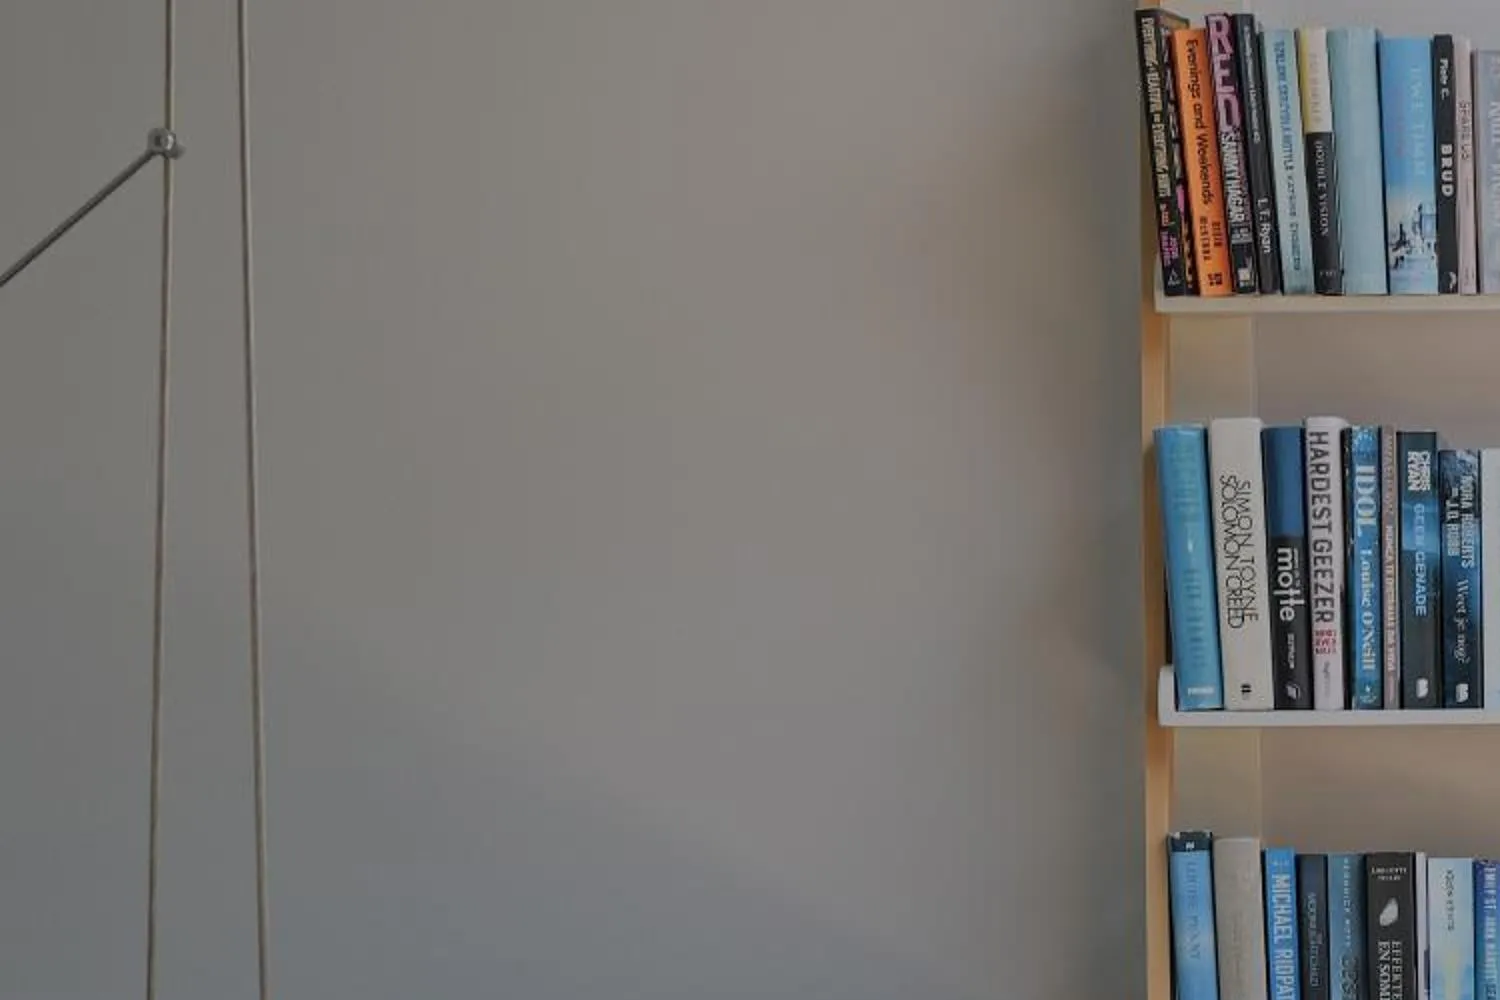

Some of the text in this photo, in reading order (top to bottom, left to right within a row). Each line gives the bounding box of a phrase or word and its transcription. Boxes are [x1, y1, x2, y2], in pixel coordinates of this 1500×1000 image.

[1186, 40, 1213, 205] Evenings and Weekends
[1221, 132, 1245, 223] SAMMY HAGAR
[1441, 143, 1455, 198] BRUD
[1258, 222, 1273, 255] Ryan
[1318, 193, 1331, 238] VISION
[1309, 431, 1333, 534] HARDEST
[1354, 464, 1377, 538] IDOL
[1408, 450, 1420, 492] RYAN
[1219, 475, 1246, 630] SOLOMON CREED
[1236, 480, 1260, 622] SIMON TOYNE
[1461, 475, 1475, 569] NORA ROBERTS
[1312, 539, 1335, 623] GEEZER
[1359, 549, 1374, 607] Louise
[1414, 551, 1427, 616] GENADE
[1270, 873, 1292, 944] MICHAEL
[1378, 941, 1391, 961] EN
